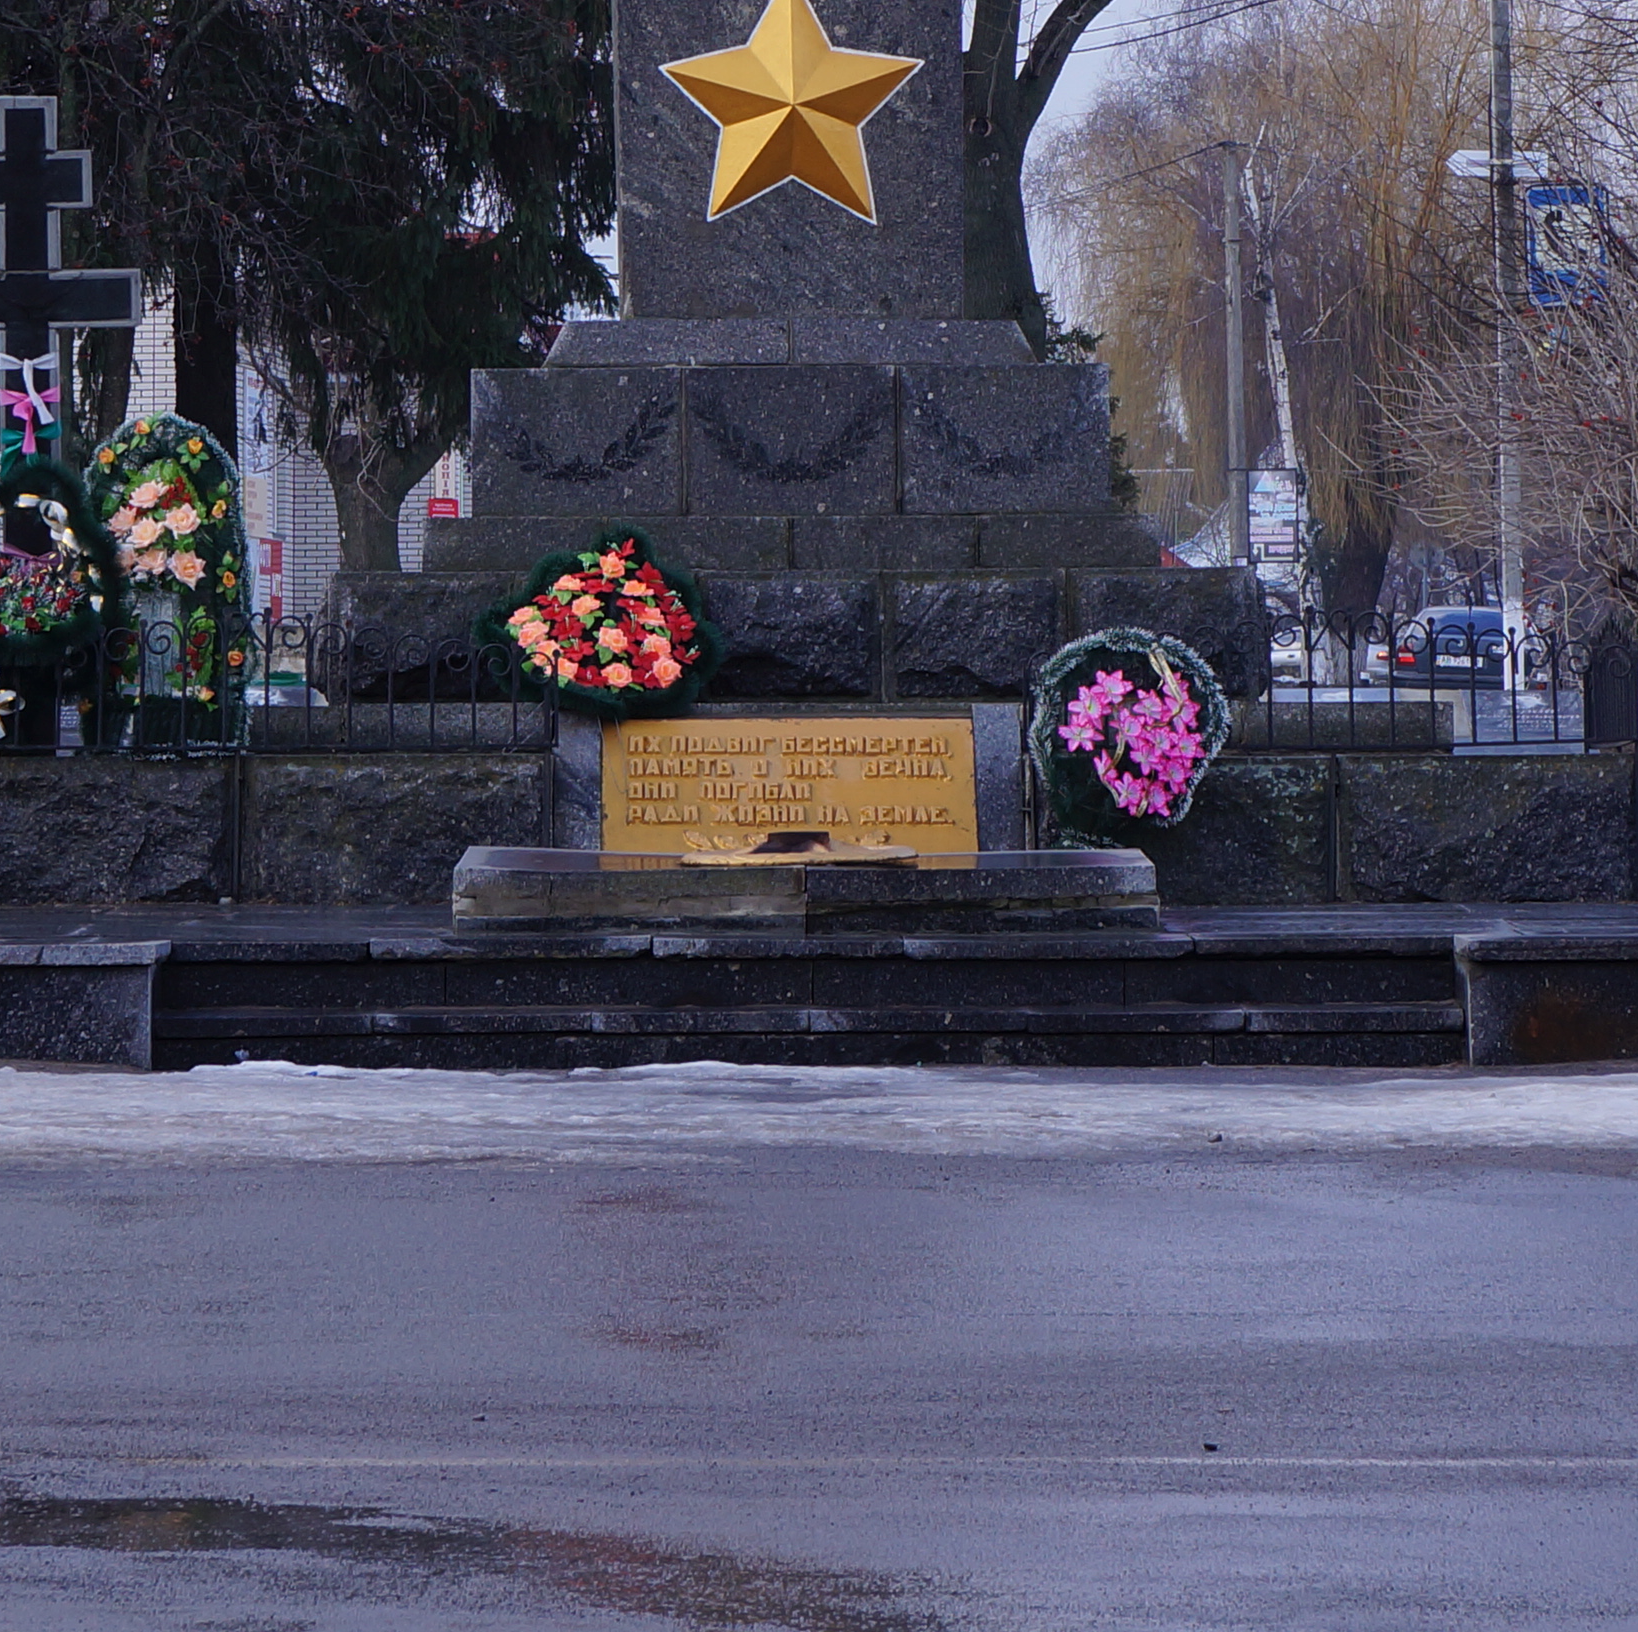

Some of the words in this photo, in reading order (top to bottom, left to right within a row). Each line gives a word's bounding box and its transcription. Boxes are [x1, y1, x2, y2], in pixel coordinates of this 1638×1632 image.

[627, 735, 661, 754] ИХ
[670, 735, 776, 755] ПОДВИГ
[781, 736, 953, 758] БЕССМЕРТЕН,
[752, 759, 769, 778] О
[784, 758, 837, 779] НИХ
[627, 781, 678, 801] ОНИ
[699, 781, 812, 802] ПОГИБЛИ
[626, 804, 700, 826] РАДИ
[711, 804, 806, 827] ЖИЗНИ
[817, 804, 851, 826] НА
[859, 805, 955, 826] ЗЕМЛЕ.
